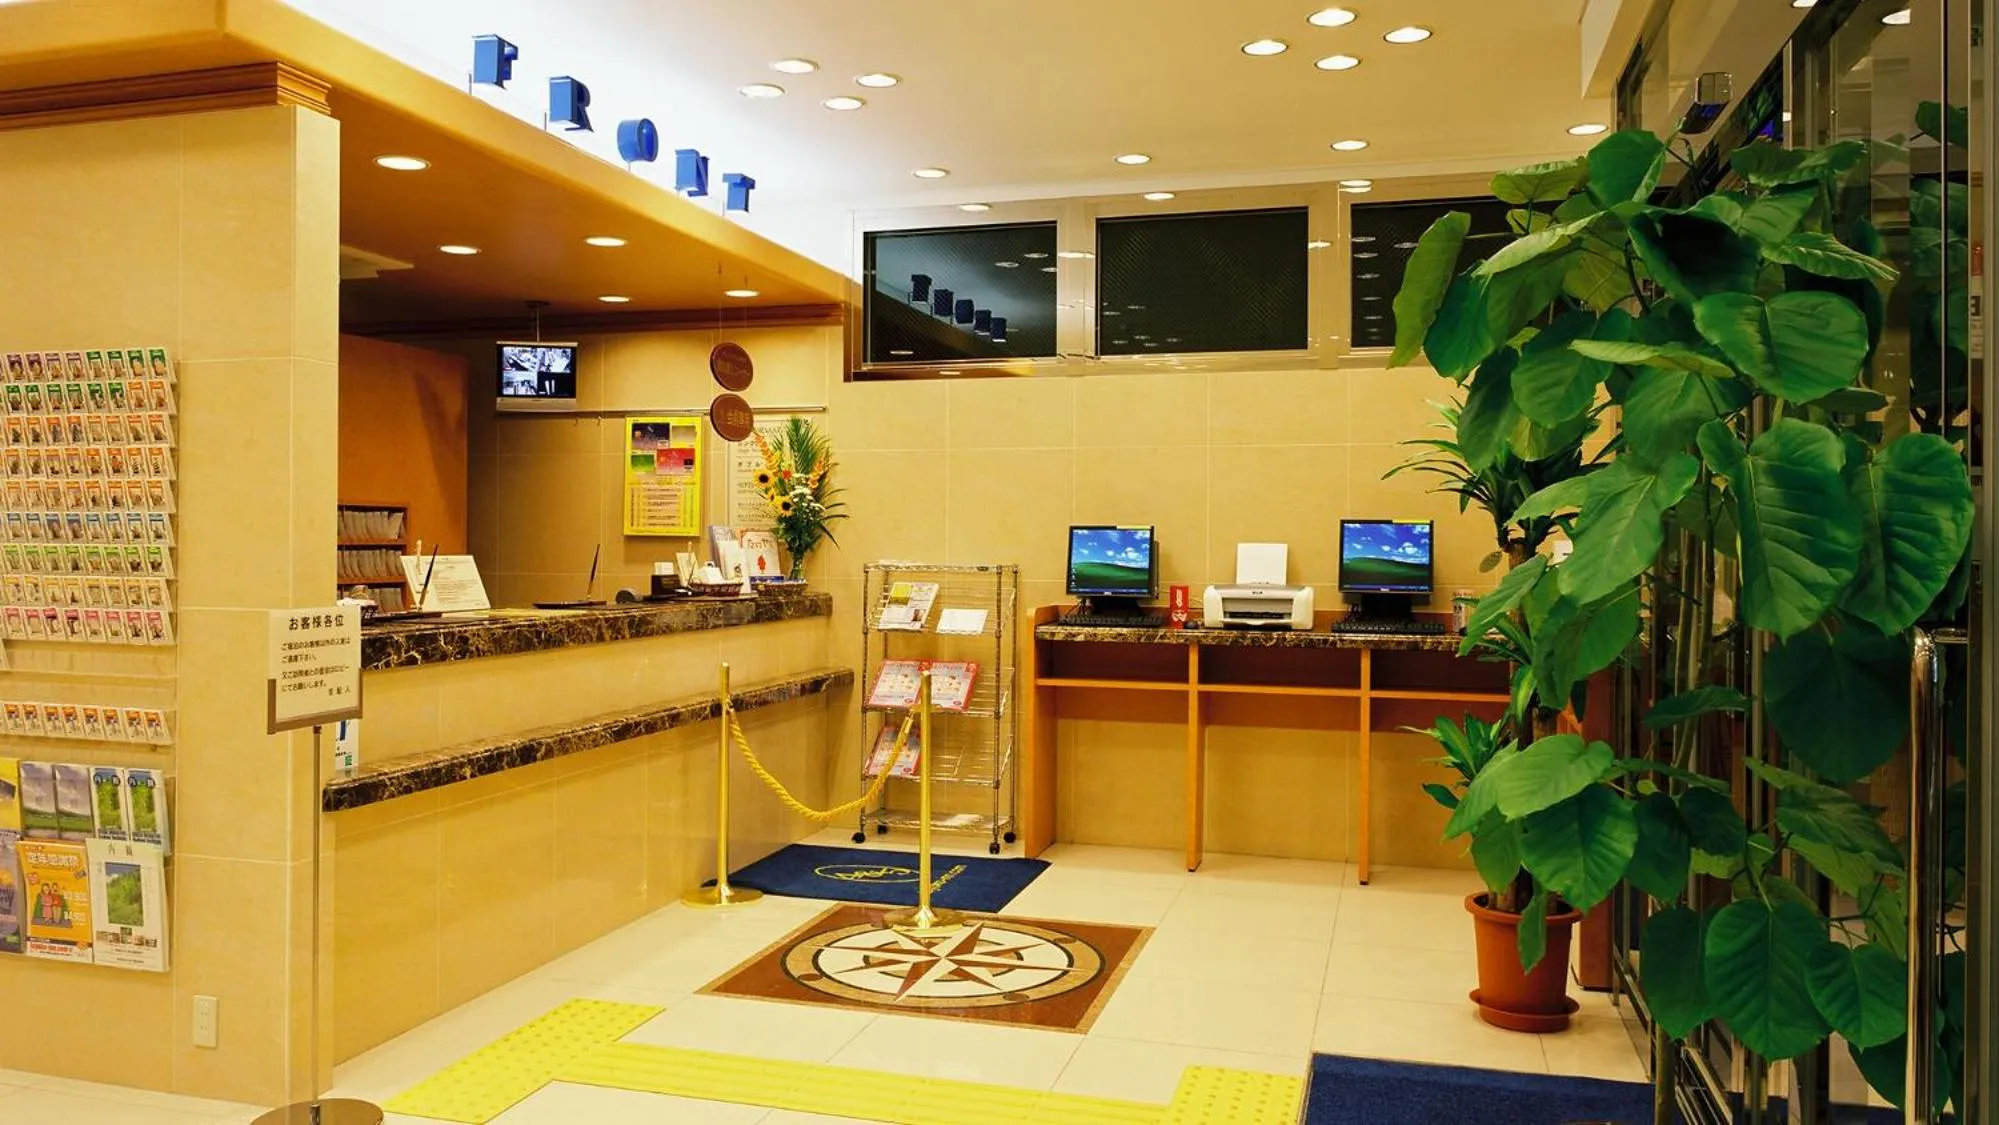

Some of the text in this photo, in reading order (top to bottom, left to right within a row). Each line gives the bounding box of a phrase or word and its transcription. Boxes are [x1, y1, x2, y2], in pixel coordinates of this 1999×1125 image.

[472, 34, 756, 212] FRONT
[289, 615, 344, 630] お客様各位
